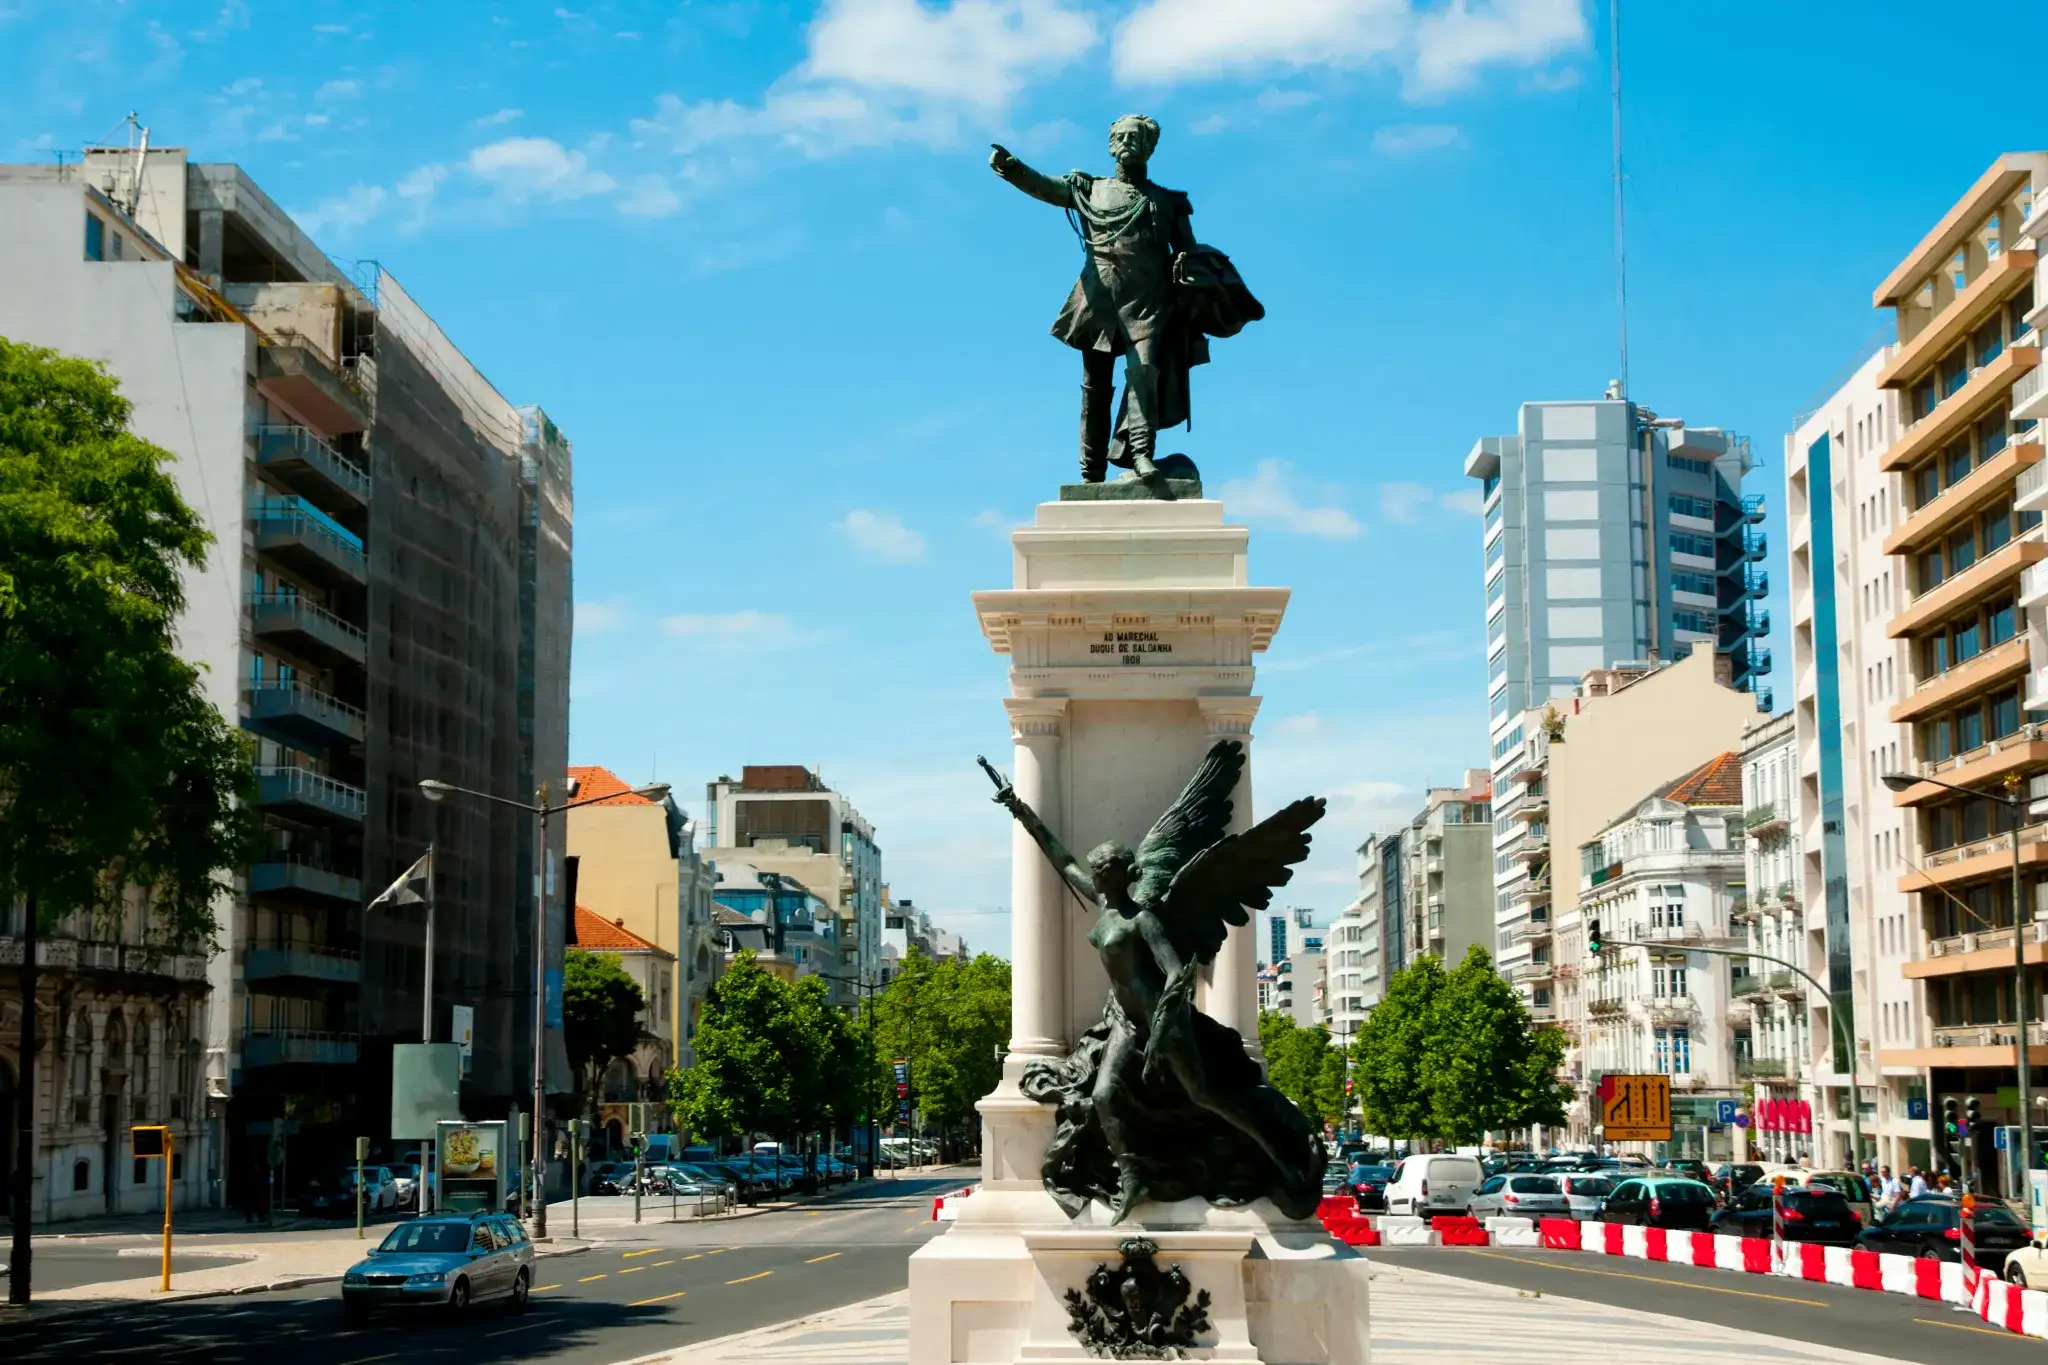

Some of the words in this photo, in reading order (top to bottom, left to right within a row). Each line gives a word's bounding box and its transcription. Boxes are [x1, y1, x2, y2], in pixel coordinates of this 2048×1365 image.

[1104, 632, 1113, 641] AO
[1117, 632, 1158, 641] MARECHAL
[1090, 644, 1115, 653] DUQUE
[1118, 644, 1128, 653] DE
[1132, 643, 1172, 653] SALDANHA
[1722, 1104, 1732, 1120] P
[1914, 1102, 1923, 1114] P
